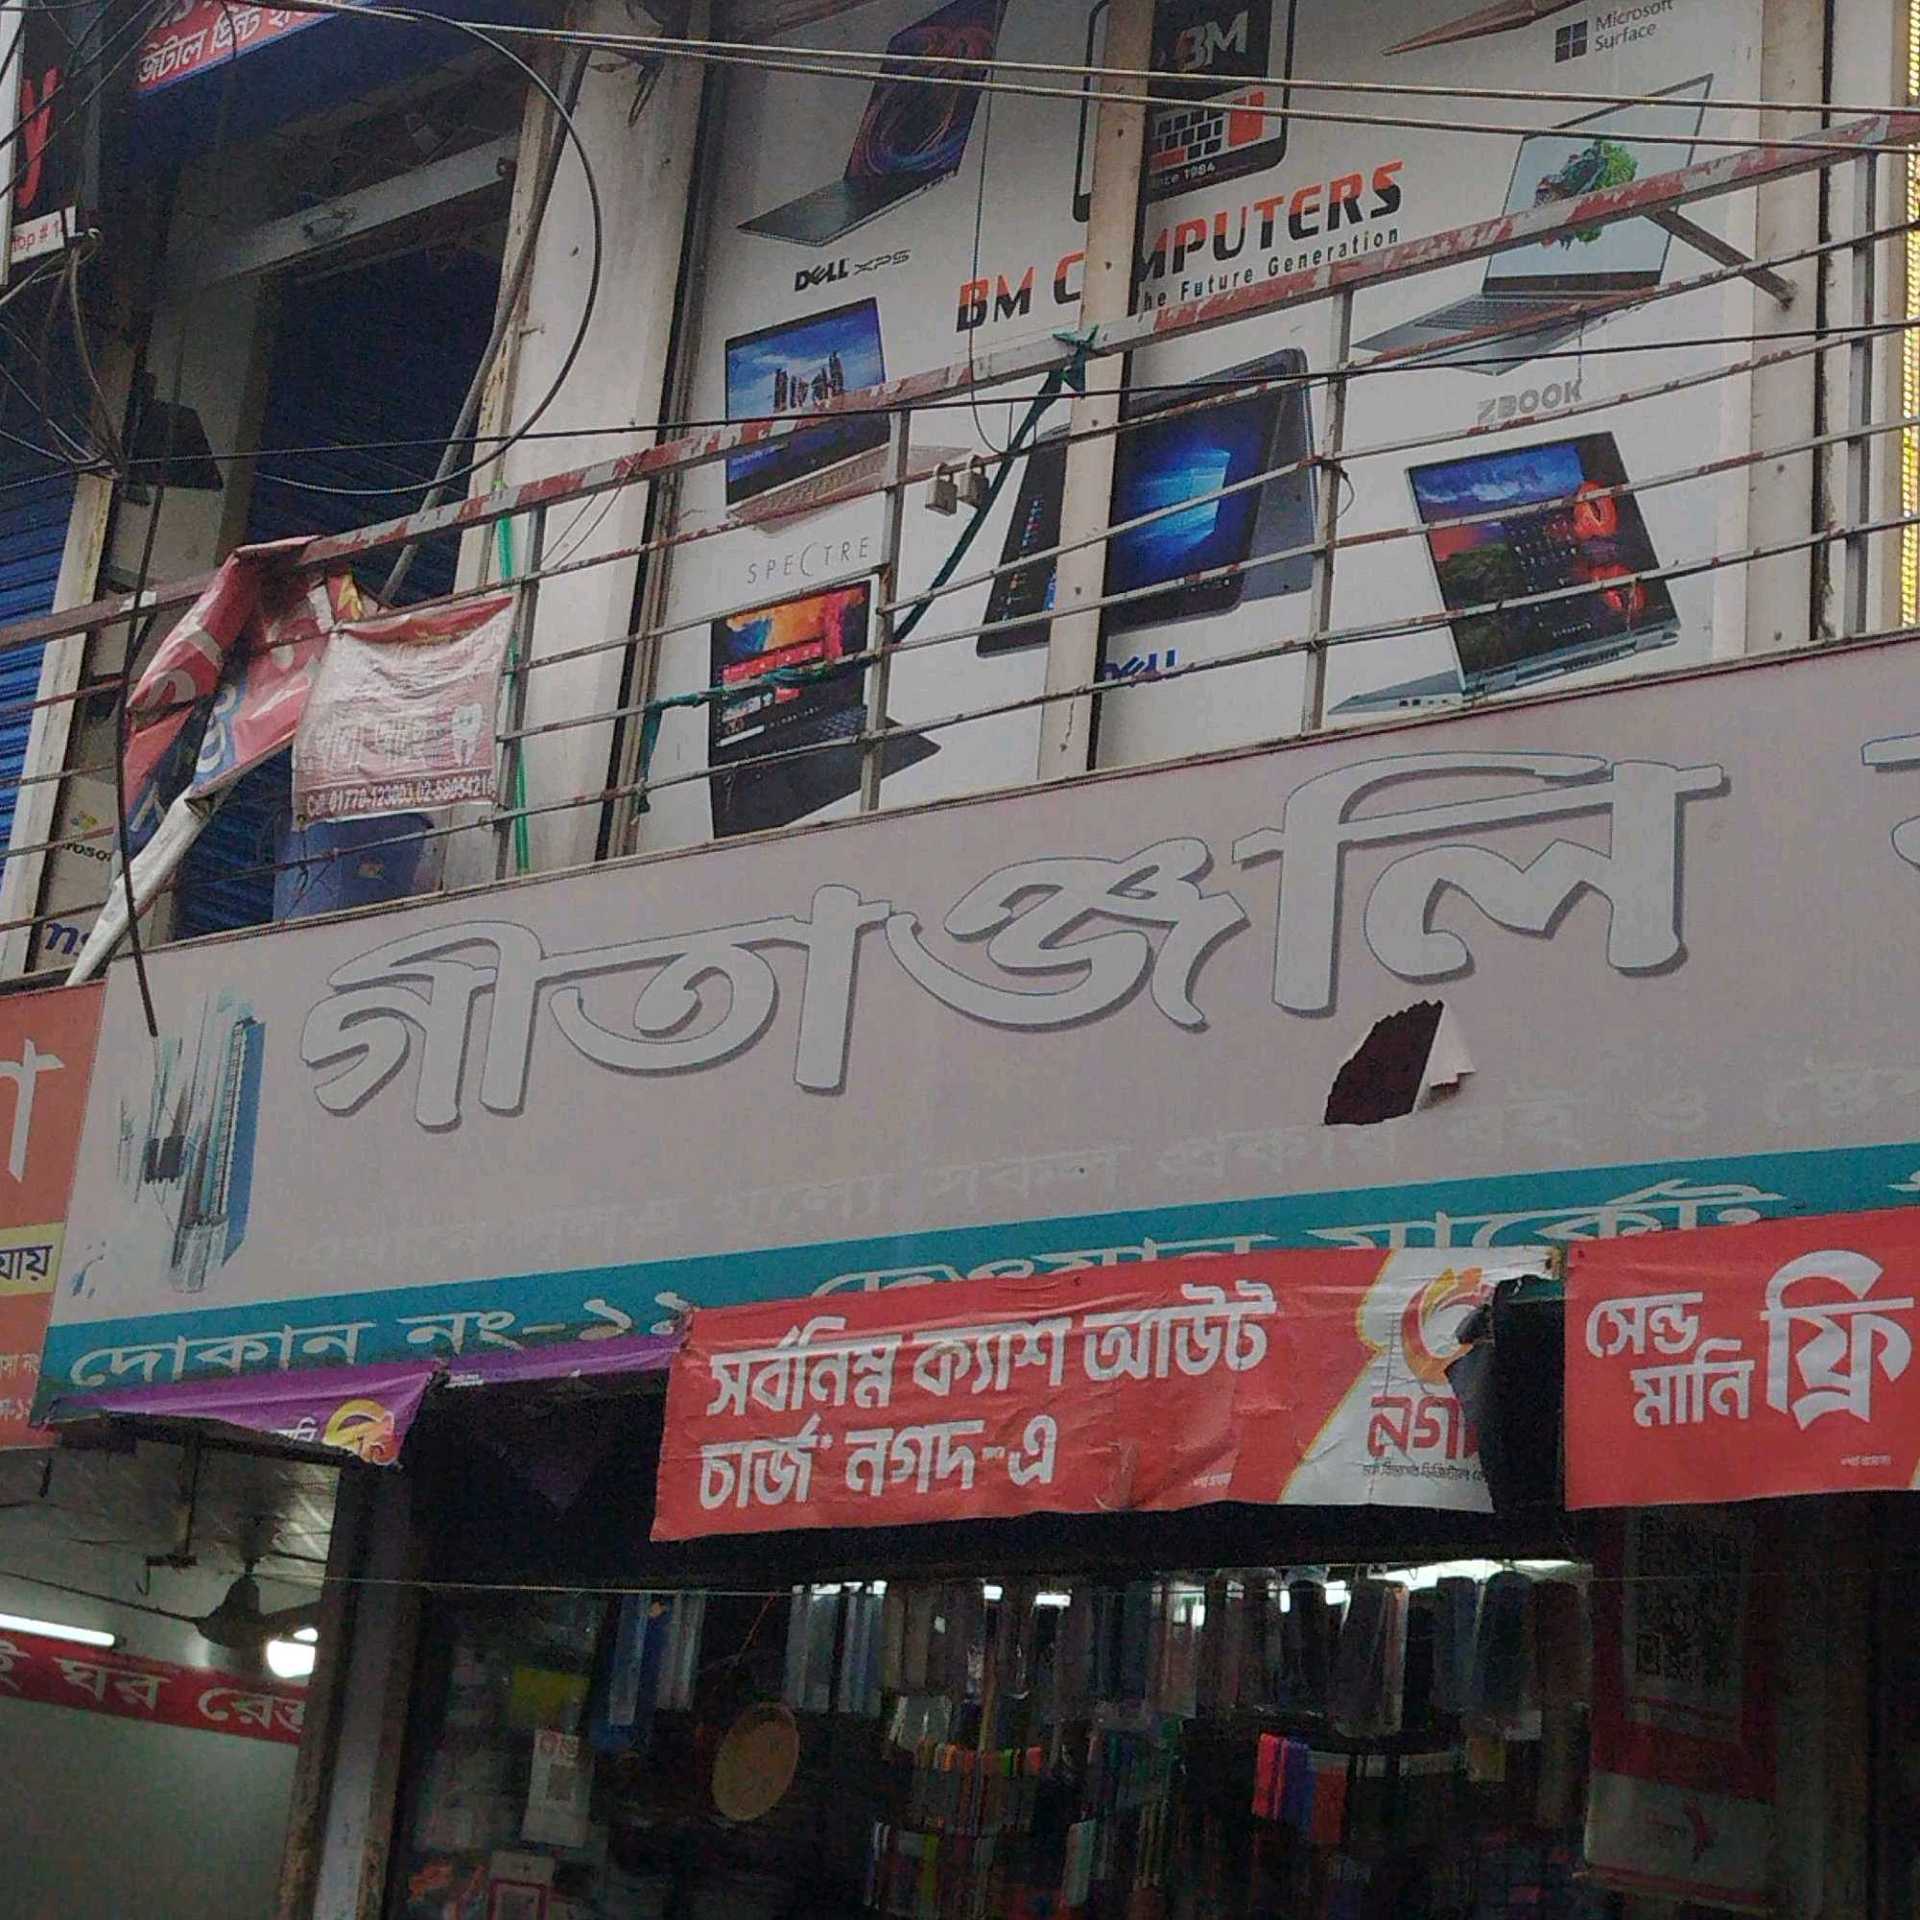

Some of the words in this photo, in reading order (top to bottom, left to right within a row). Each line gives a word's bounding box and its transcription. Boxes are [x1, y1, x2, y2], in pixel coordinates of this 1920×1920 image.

[1595, 23, 1658, 52] Surface
[1596, 0, 1673, 31] Microsoft
[794, 257, 850, 292] DELL
[854, 247, 911, 276] XPS
[956, 266, 1035, 333] BM
[1053, 160, 1403, 306] CMPUTERS
[1180, 267, 1254, 299] Future
[1267, 226, 1400, 277] Generation
[1477, 380, 1583, 424] ZBOOK
[747, 536, 870, 585] SPECTRE
[301, 750, 1731, 1134] গীতাঞ্জলি
[70, 1321, 377, 1388] দোকান
[706, 1315, 903, 1417] সর্বনিম্ন
[911, 1316, 1073, 1397] ক্যাশ
[1083, 1279, 1278, 1381] আউট
[1586, 1291, 1704, 1359] সেন্ড
[1759, 1249, 1915, 1431] ফ্রি
[1629, 1338, 1755, 1428] মানি
[844, 1414, 1058, 1497] নগদ-এ
[1367, 1395, 1481, 1459] নগ
